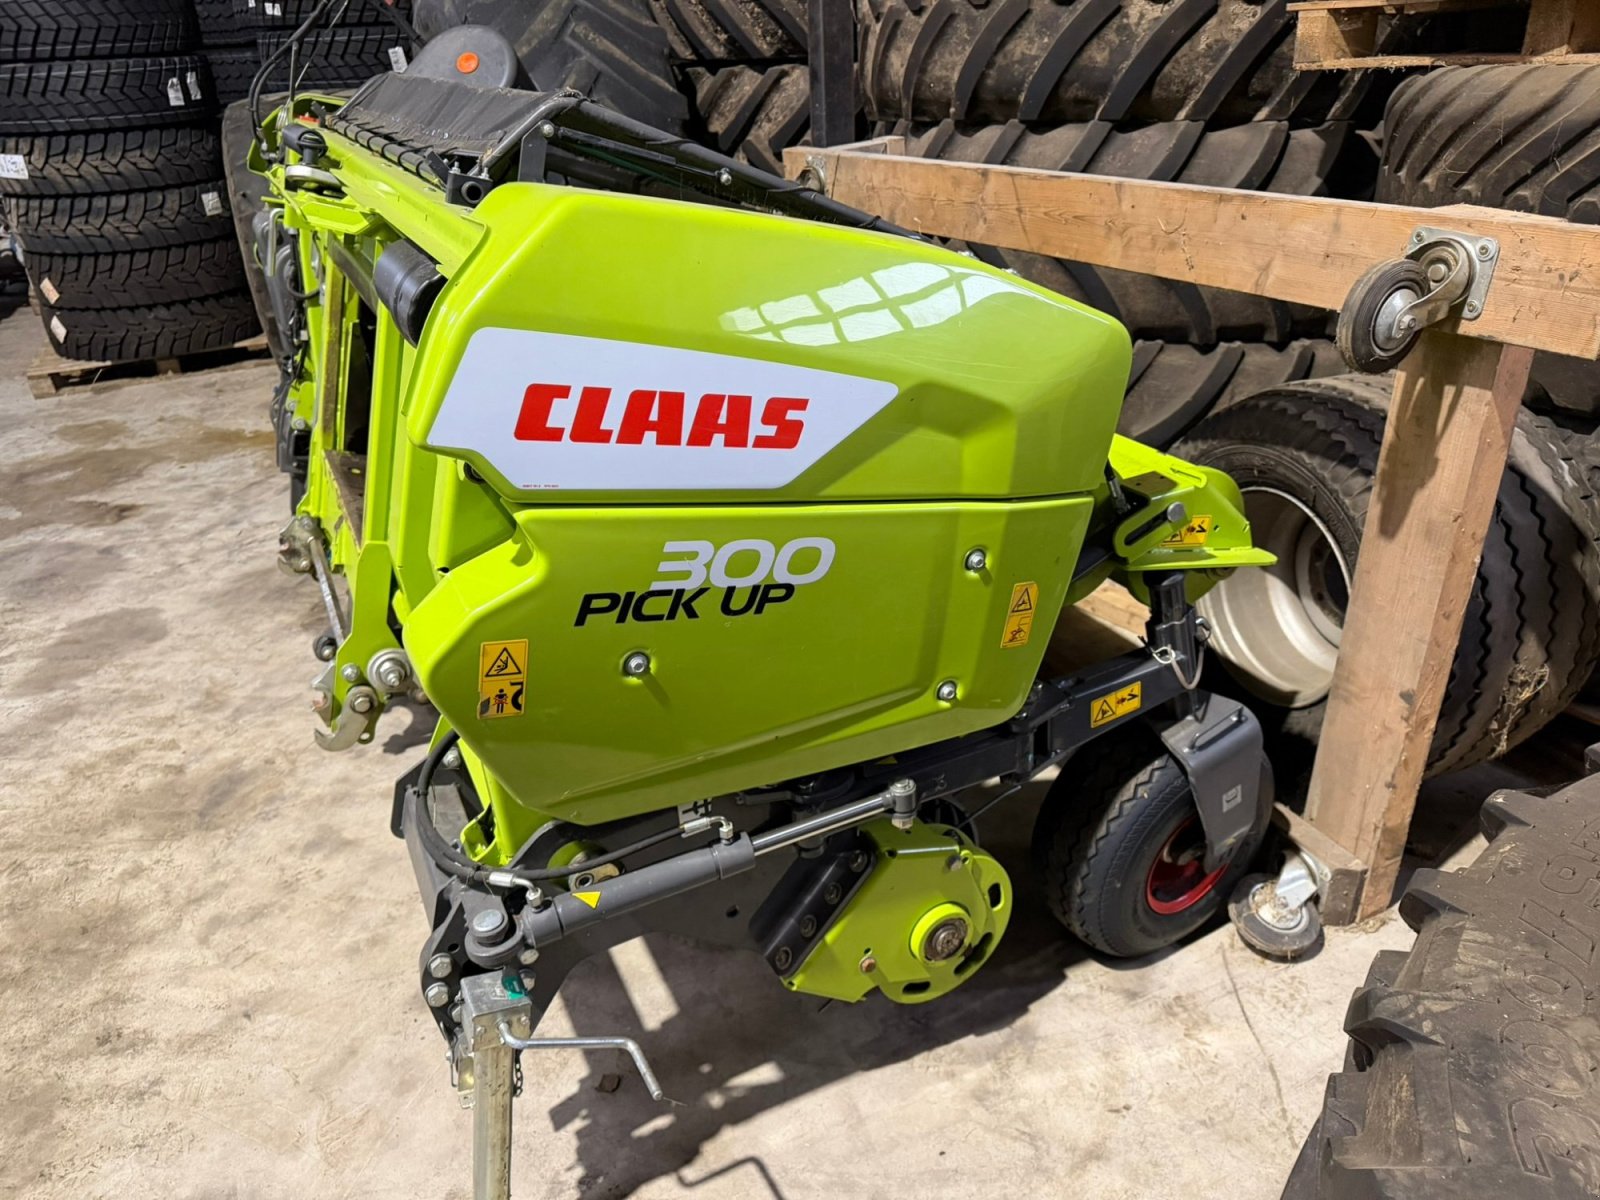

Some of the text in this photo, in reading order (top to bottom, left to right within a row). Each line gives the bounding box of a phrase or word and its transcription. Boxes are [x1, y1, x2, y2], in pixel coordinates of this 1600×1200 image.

[513, 383, 810, 449] CLAAS
[649, 537, 836, 591] 300
[573, 583, 795, 627] PICK UP
